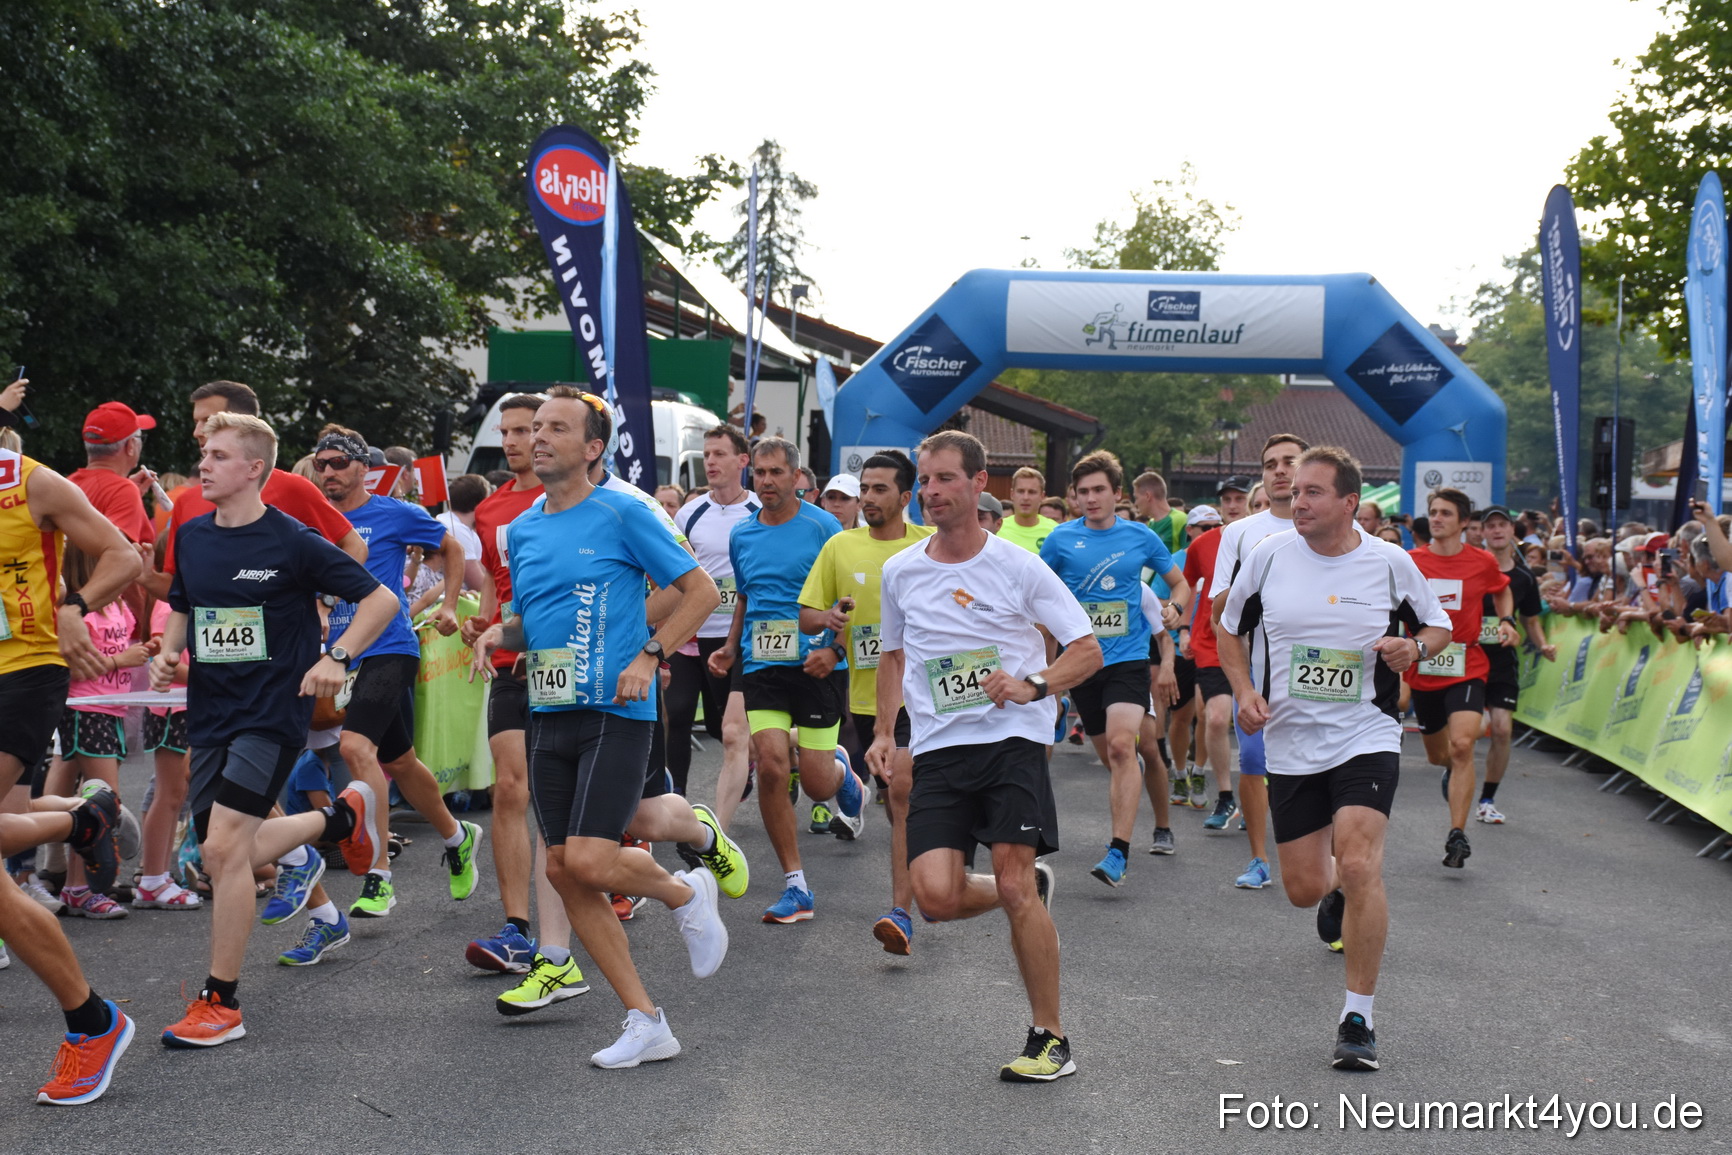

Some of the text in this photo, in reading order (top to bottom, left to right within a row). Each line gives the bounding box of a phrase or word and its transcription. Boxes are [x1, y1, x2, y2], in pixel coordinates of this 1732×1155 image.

[1158, 298, 1198, 312] Fischer
[1128, 321, 1245, 344] firmenlauf
[1127, 343, 1175, 352] neumarkt
[905, 354, 967, 370] Fischer
[910, 369, 961, 377] AUTOMOBILE
[579, 547, 595, 556] Udo
[1090, 558, 1111, 574] Schick
[1111, 550, 1125, 559] Bau
[232, 569, 266, 580] JURA
[572, 583, 596, 605] di
[202, 627, 254, 647] 1448
[594, 582, 610, 704] Nathalies Bedienservice
[757, 634, 791, 649] 1727
[532, 668, 566, 690] 1740
[1298, 664, 1353, 688] 2370
